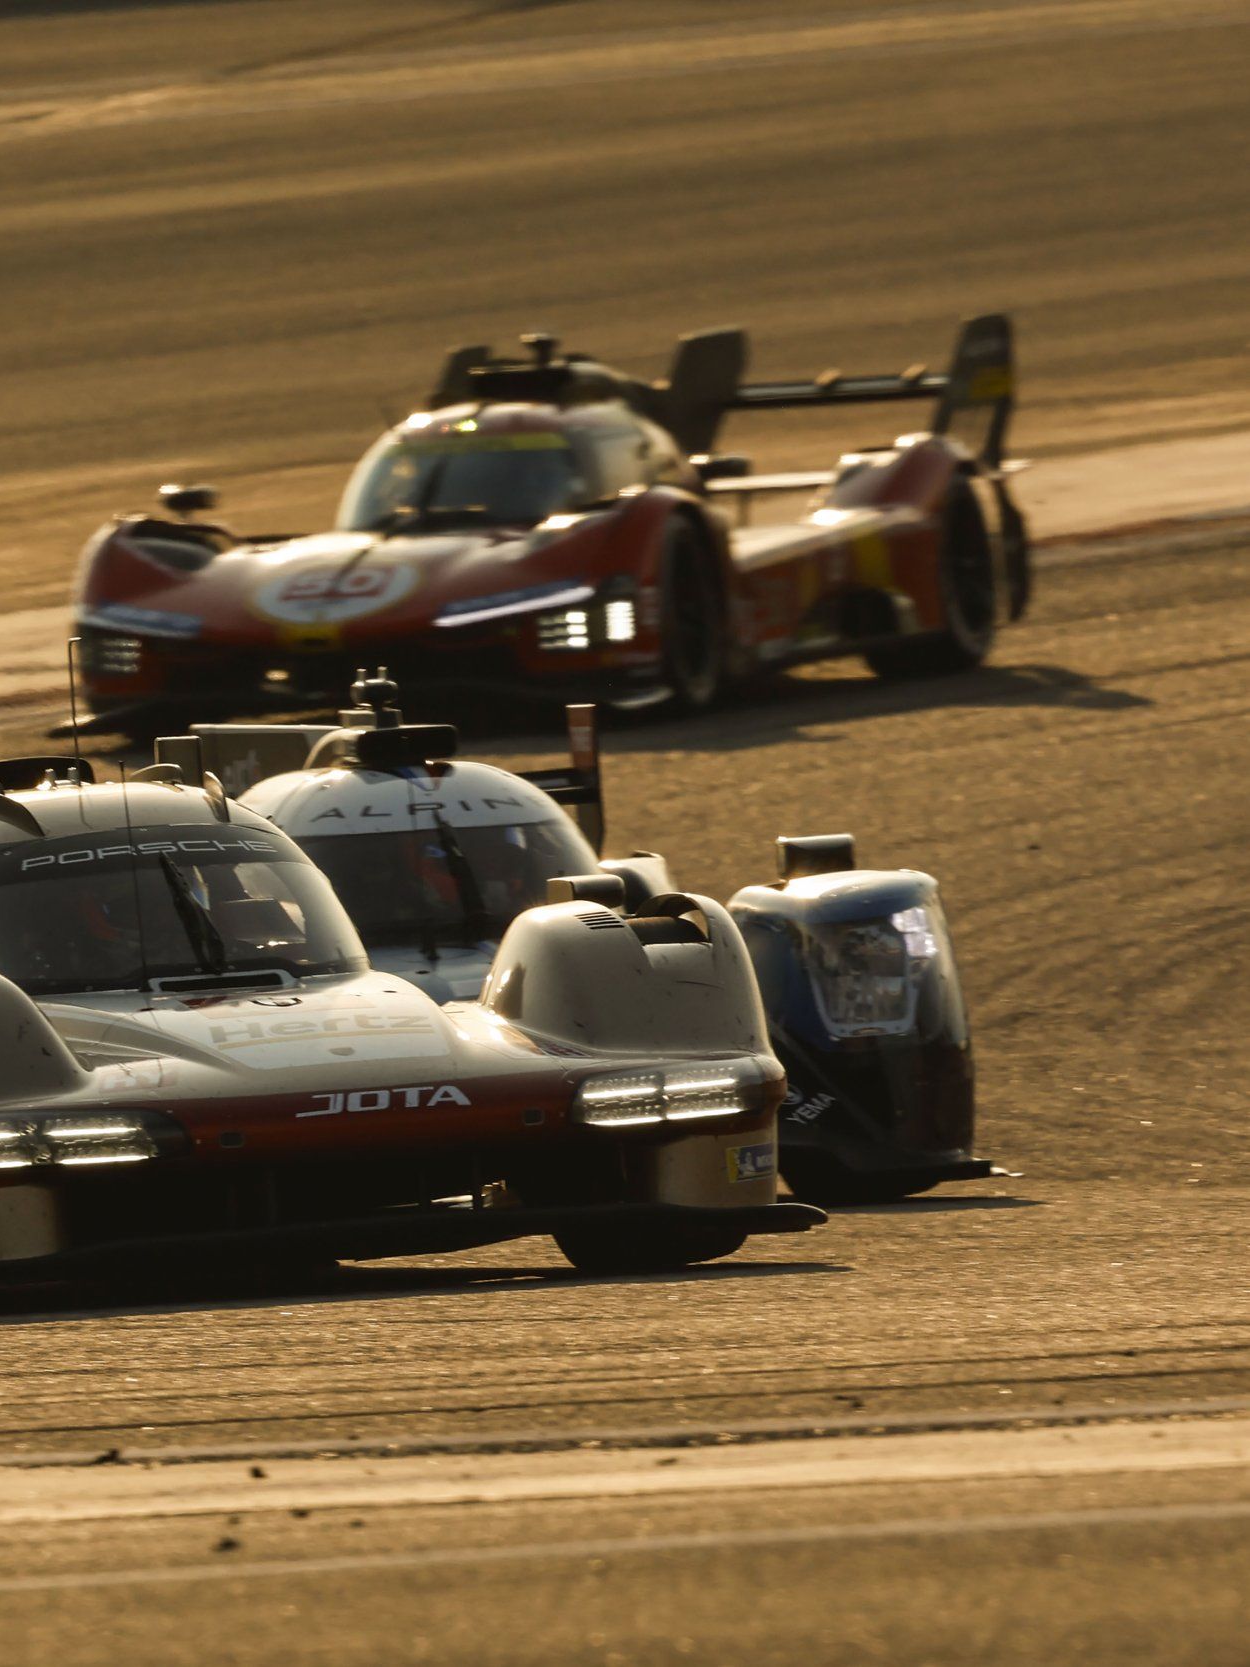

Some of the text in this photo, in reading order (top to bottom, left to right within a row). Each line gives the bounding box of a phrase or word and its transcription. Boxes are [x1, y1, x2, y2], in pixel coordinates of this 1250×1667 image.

[309, 796, 543, 823] ALPIN
[21, 840, 278, 871] PORSCHE
[209, 1014, 433, 1044] Hertz
[295, 1085, 472, 1118] JOTA
[785, 1092, 836, 1125] YEMA
